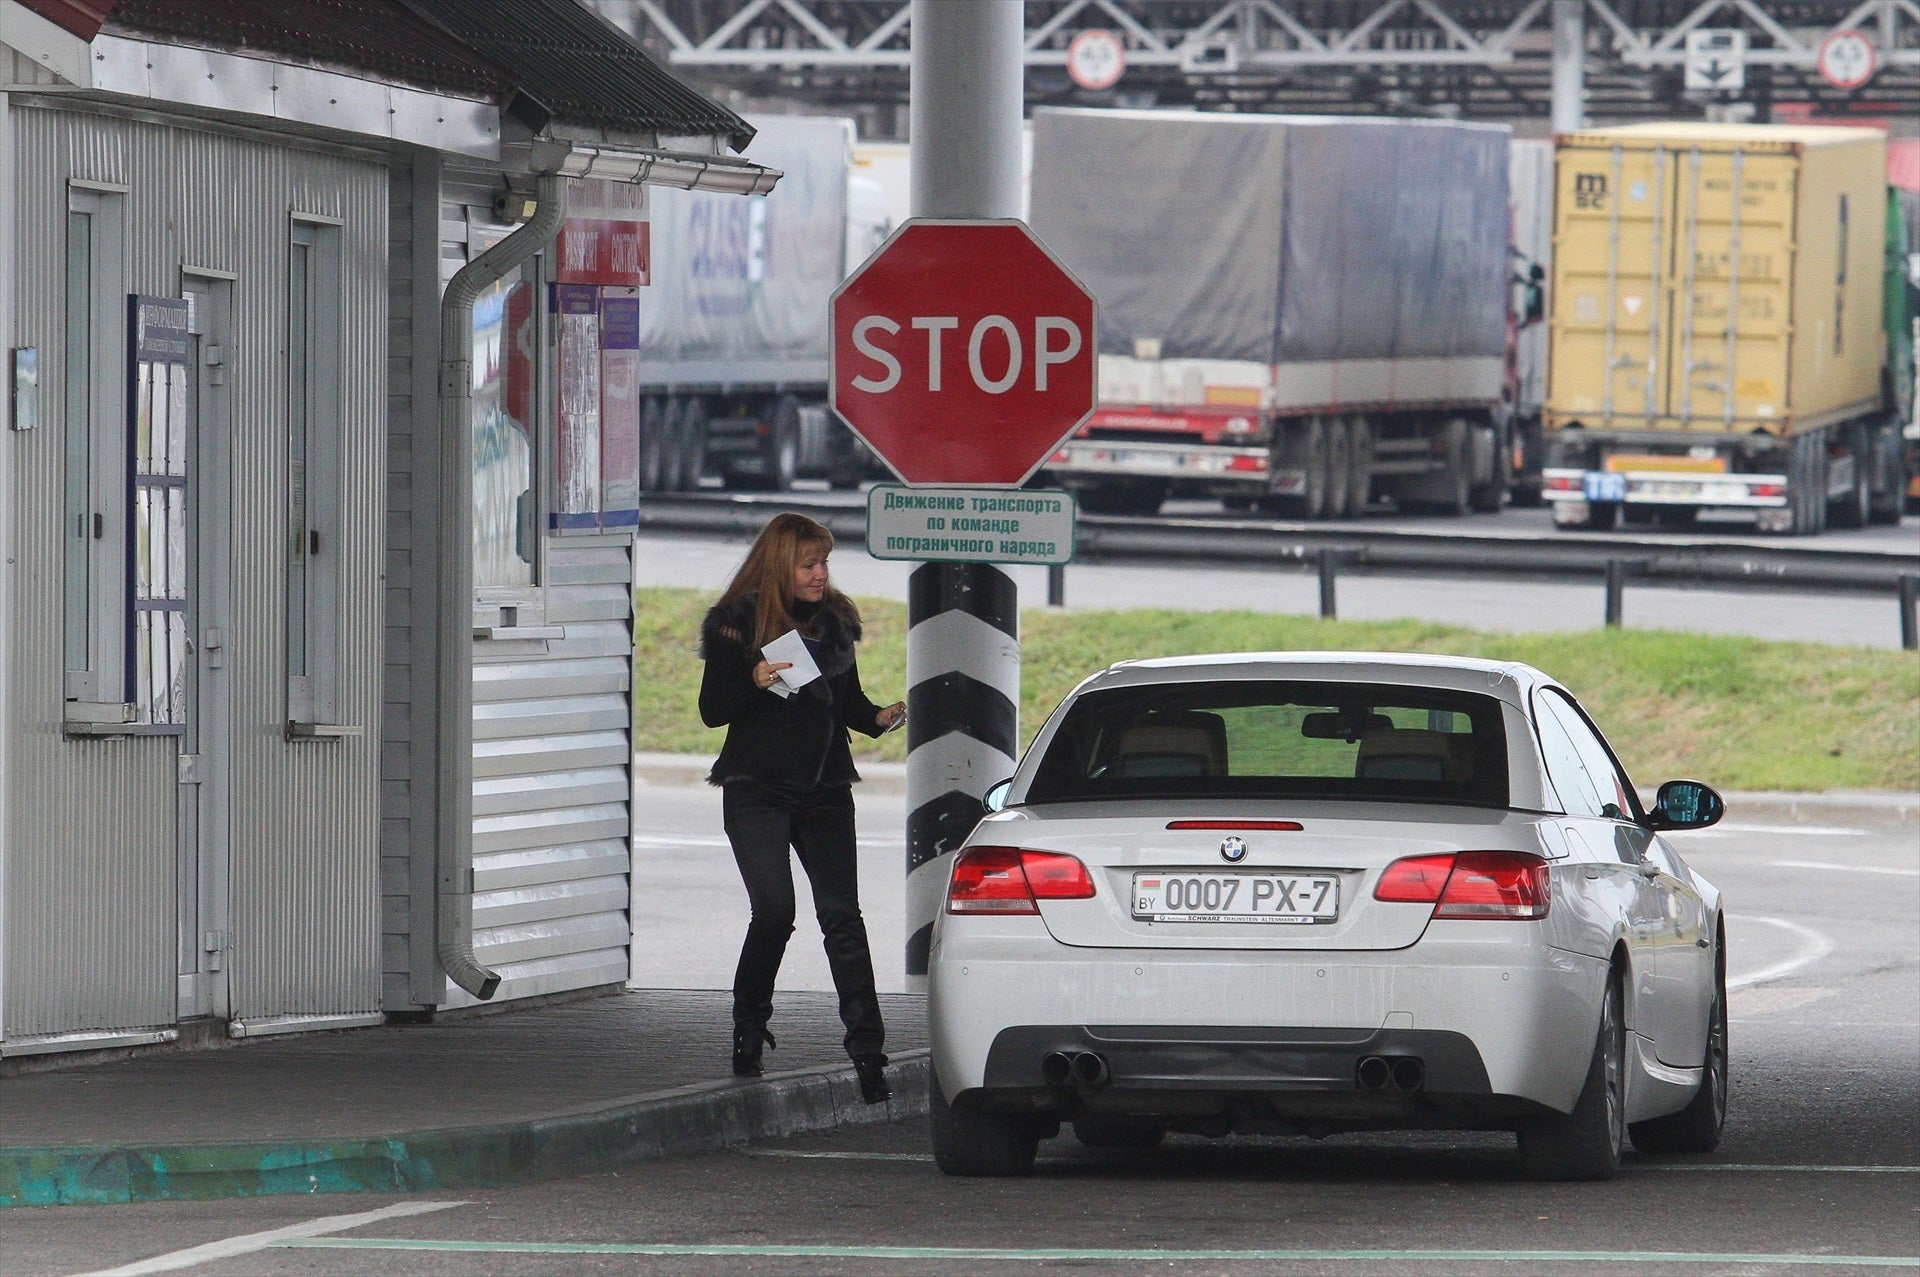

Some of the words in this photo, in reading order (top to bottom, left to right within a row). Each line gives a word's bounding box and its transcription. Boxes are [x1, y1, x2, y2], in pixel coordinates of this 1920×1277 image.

[565, 231, 599, 272] PASSPORT
[851, 314, 1082, 394] STOP
[884, 492, 965, 511] Движение
[971, 497, 1062, 515] транспорта
[926, 517, 946, 531] по
[951, 518, 1020, 534] команде
[886, 536, 994, 553] пограничного
[1000, 541, 1056, 556] наряда
[1139, 897, 1157, 910] BY
[1165, 878, 1241, 911] 0007
[1251, 879, 1331, 913] PX-7
